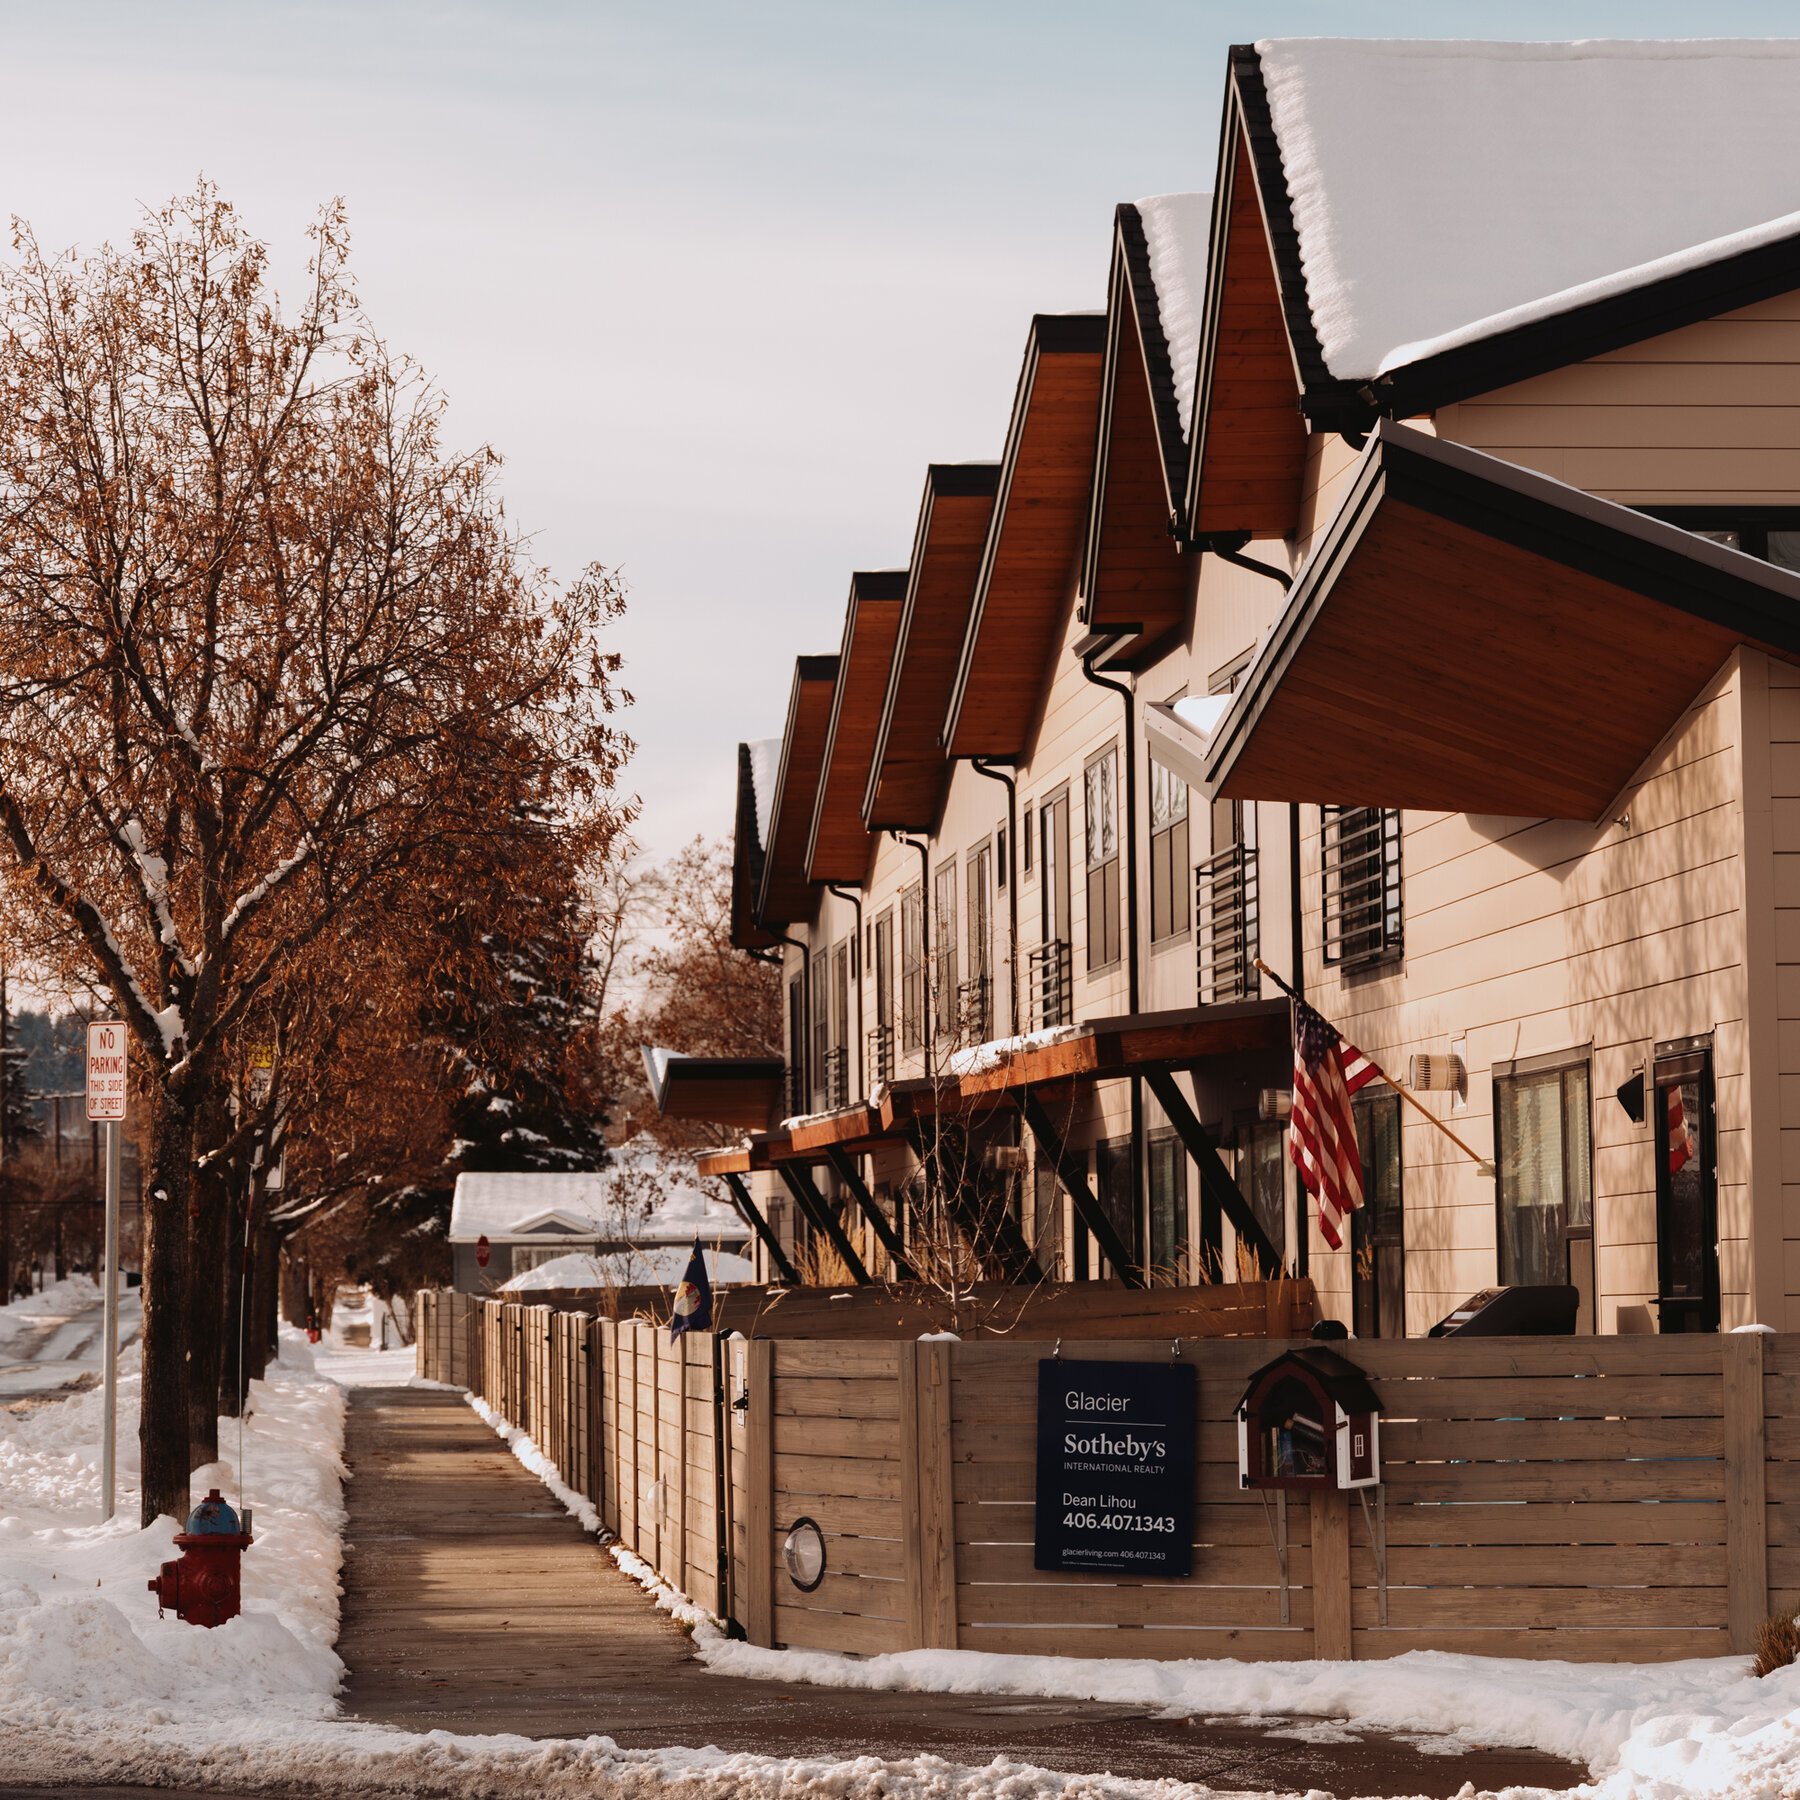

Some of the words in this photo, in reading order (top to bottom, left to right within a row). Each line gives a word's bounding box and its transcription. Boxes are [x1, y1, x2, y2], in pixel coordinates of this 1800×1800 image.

[99, 1031, 115, 1049] NO
[90, 1056, 123, 1074] PARKING
[90, 1080, 105, 1092] THIS
[108, 1079, 123, 1092] SIDE
[89, 1097, 98, 1110] OF
[100, 1097, 123, 1110] STREET
[1065, 1390, 1131, 1412] Glacier
[1063, 1432, 1167, 1462] Sotheby's
[1063, 1462, 1132, 1473] INTERNATIONAL
[1133, 1465, 1166, 1474] REALTY
[1062, 1492, 1096, 1507] Dean
[1099, 1494, 1137, 1509] Lihou
[1062, 1512, 1176, 1533] 406.407.1343
[1062, 1548, 1119, 1559] glacierliving.com
[1119, 1550, 1166, 1561] 406.407.1343
